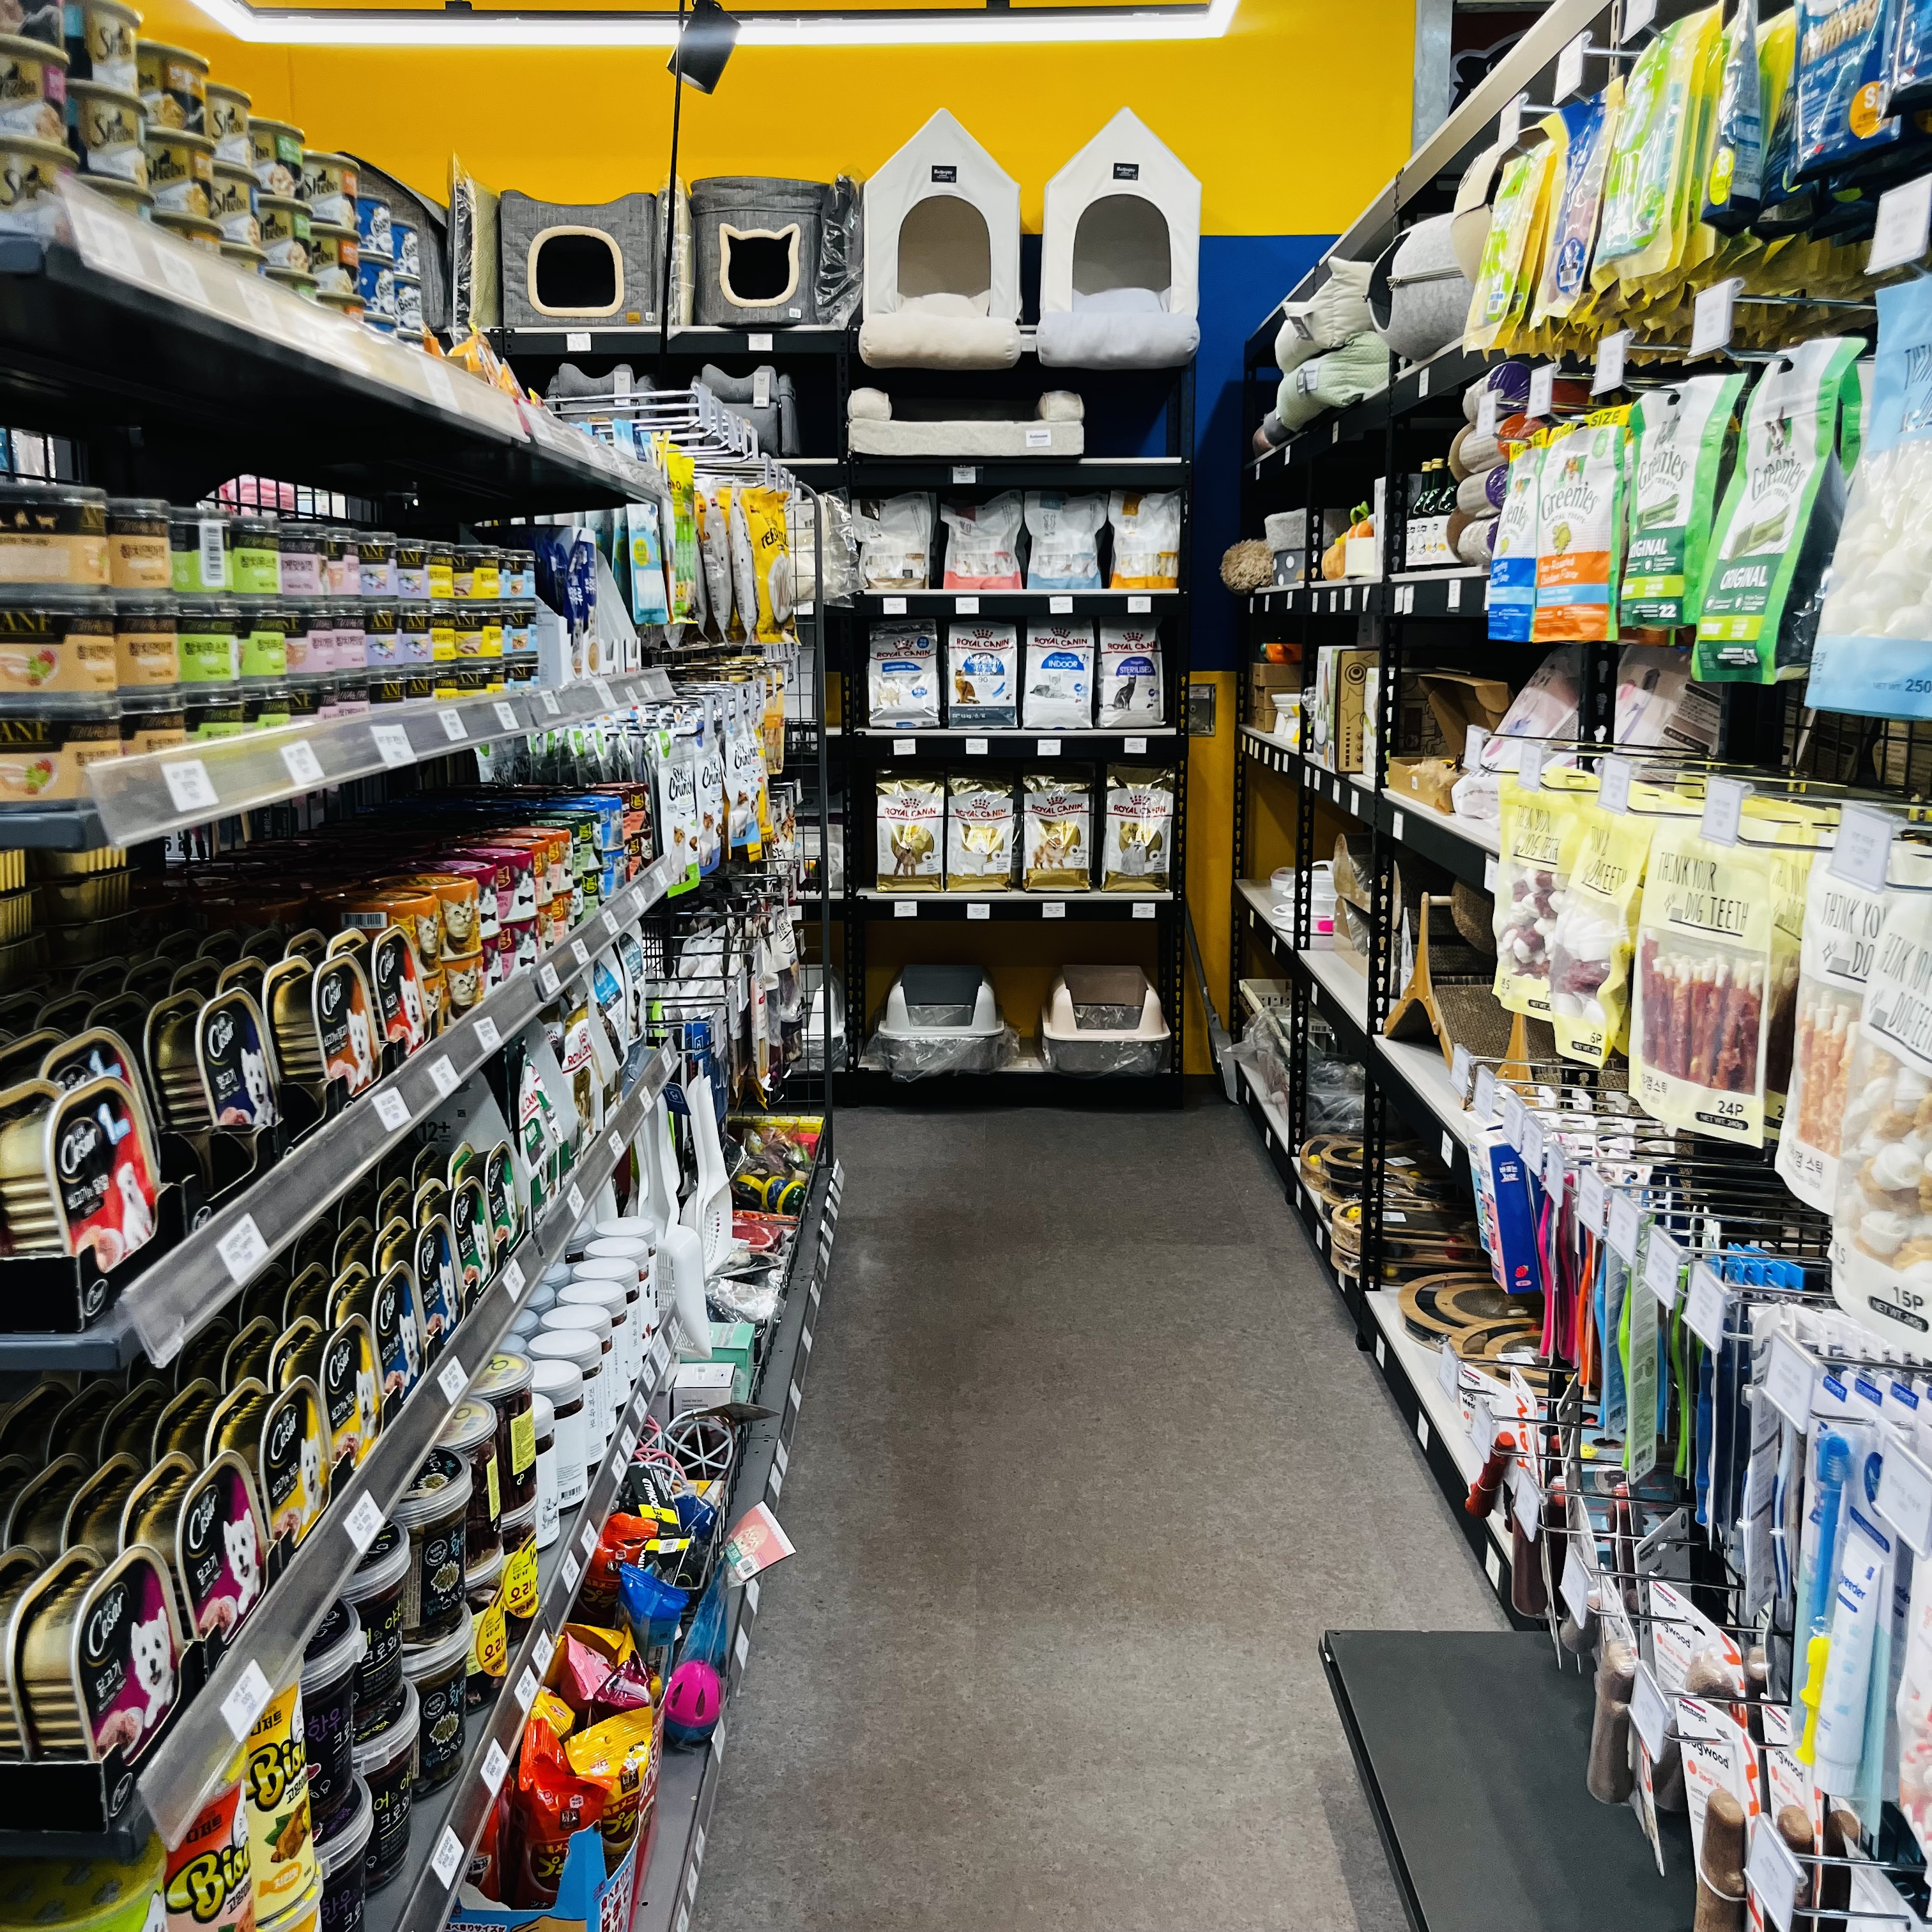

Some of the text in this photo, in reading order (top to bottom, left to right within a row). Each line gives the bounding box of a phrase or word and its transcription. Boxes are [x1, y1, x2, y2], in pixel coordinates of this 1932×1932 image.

[1864, 86, 1876, 109] S
[1590, 410, 1621, 427] SIZE
[1638, 443, 1688, 490] Greenies
[1752, 452, 1805, 502] Greenies
[1542, 482, 1598, 521] Greenies
[453, 556, 468, 568] NF
[1719, 565, 1768, 590] ORIGINAL
[1658, 603, 1677, 618] 22
[956, 638, 1010, 648] ROYAL CANIN
[1034, 637, 1088, 647] ROYAL CANIN
[877, 650, 902, 658] ROYAL
[1048, 660, 1078, 668] INDOOR
[1119, 666, 1152, 674] STERILISED
[458, 673, 481, 685] ANF
[885, 808, 937, 817] ROYAL CANIN
[955, 808, 1007, 818] ROYAL CANIN
[1031, 803, 1084, 813] ROYAL CANIN
[1114, 804, 1137, 813] ROYAL
[1657, 852, 1690, 886] THINK
[1692, 858, 1717, 893] YOUR
[1684, 892, 1750, 931] DOG TEETH
[1821, 892, 1860, 934] THINK
[1851, 940, 1875, 977] DO
[1590, 1032, 1602, 1044] 6P
[1653, 1079, 1667, 1094] 스틱
[1717, 1100, 1744, 1117] 24P
[1699, 1114, 1713, 1123] NET
[1804, 1157, 1824, 1179] 스틱
[1893, 1286, 1924, 1311] 15P
[189, 1494, 217, 1549] Cesar
[197, 1552, 218, 1586] 닭고기
[509, 1582, 532, 1604] 오리
[89, 1591, 124, 1657] Cesar
[96, 1659, 123, 1699] 닭고기
[1678, 1700, 1708, 1724] Petstages
[1699, 1771, 1713, 1786] Real
[602, 1808, 638, 1836] プチ
